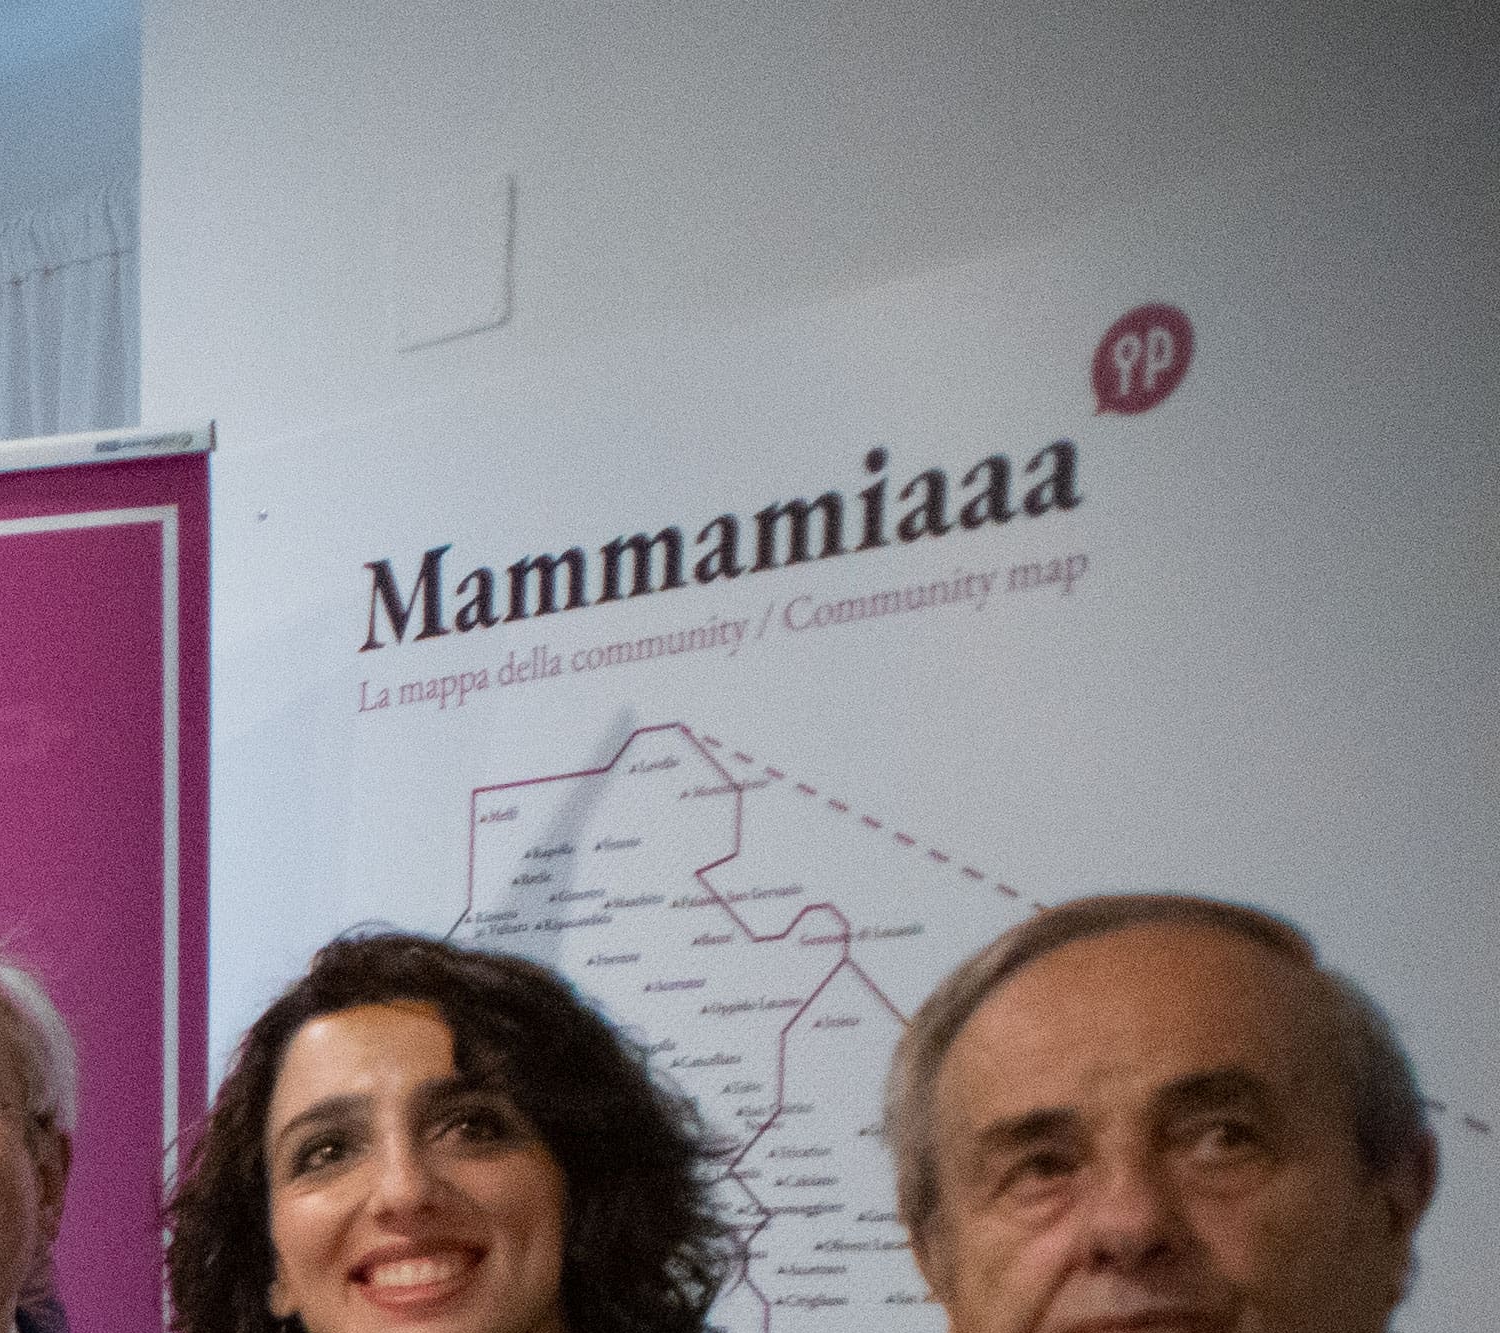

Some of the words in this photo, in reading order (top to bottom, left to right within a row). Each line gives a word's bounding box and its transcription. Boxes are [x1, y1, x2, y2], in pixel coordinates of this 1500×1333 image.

[357, 437, 1082, 651] Mammamiaaa
[358, 680, 390, 711] La
[398, 667, 488, 709] mappa
[500, 644, 563, 686] della
[571, 614, 749, 673] community
[782, 567, 997, 632] Community
[1008, 552, 1088, 597] map
